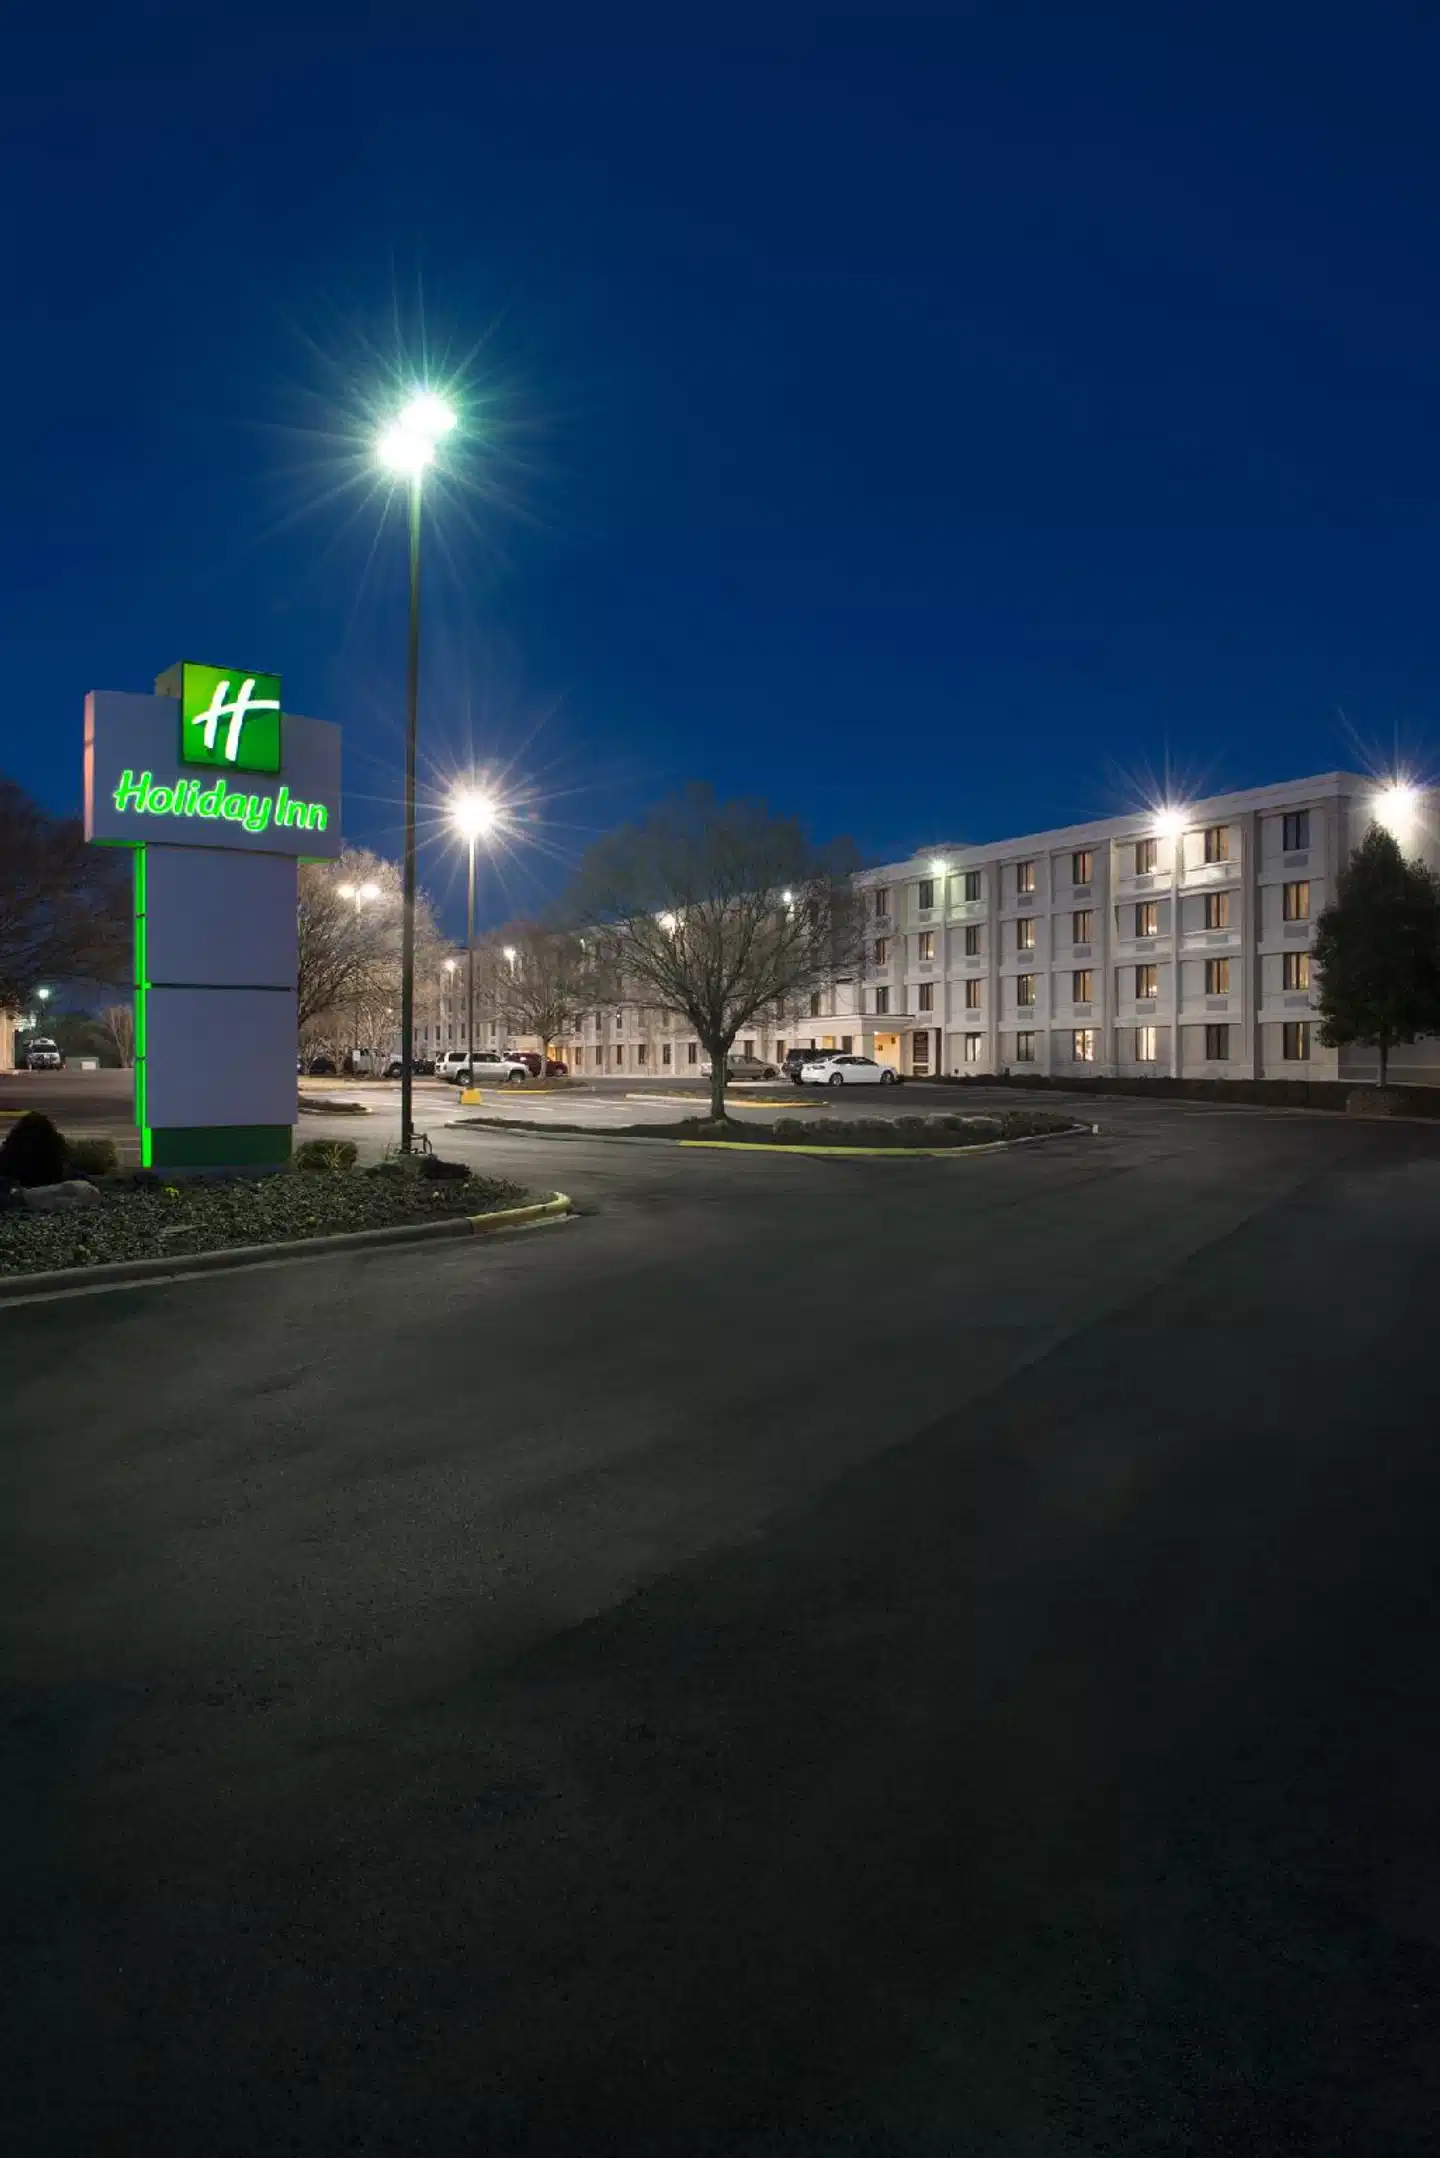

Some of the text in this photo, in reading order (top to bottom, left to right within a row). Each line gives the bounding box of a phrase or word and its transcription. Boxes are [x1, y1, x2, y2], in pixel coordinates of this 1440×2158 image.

[191, 678, 280, 761] H
[113, 770, 328, 832] Holiday Inn
